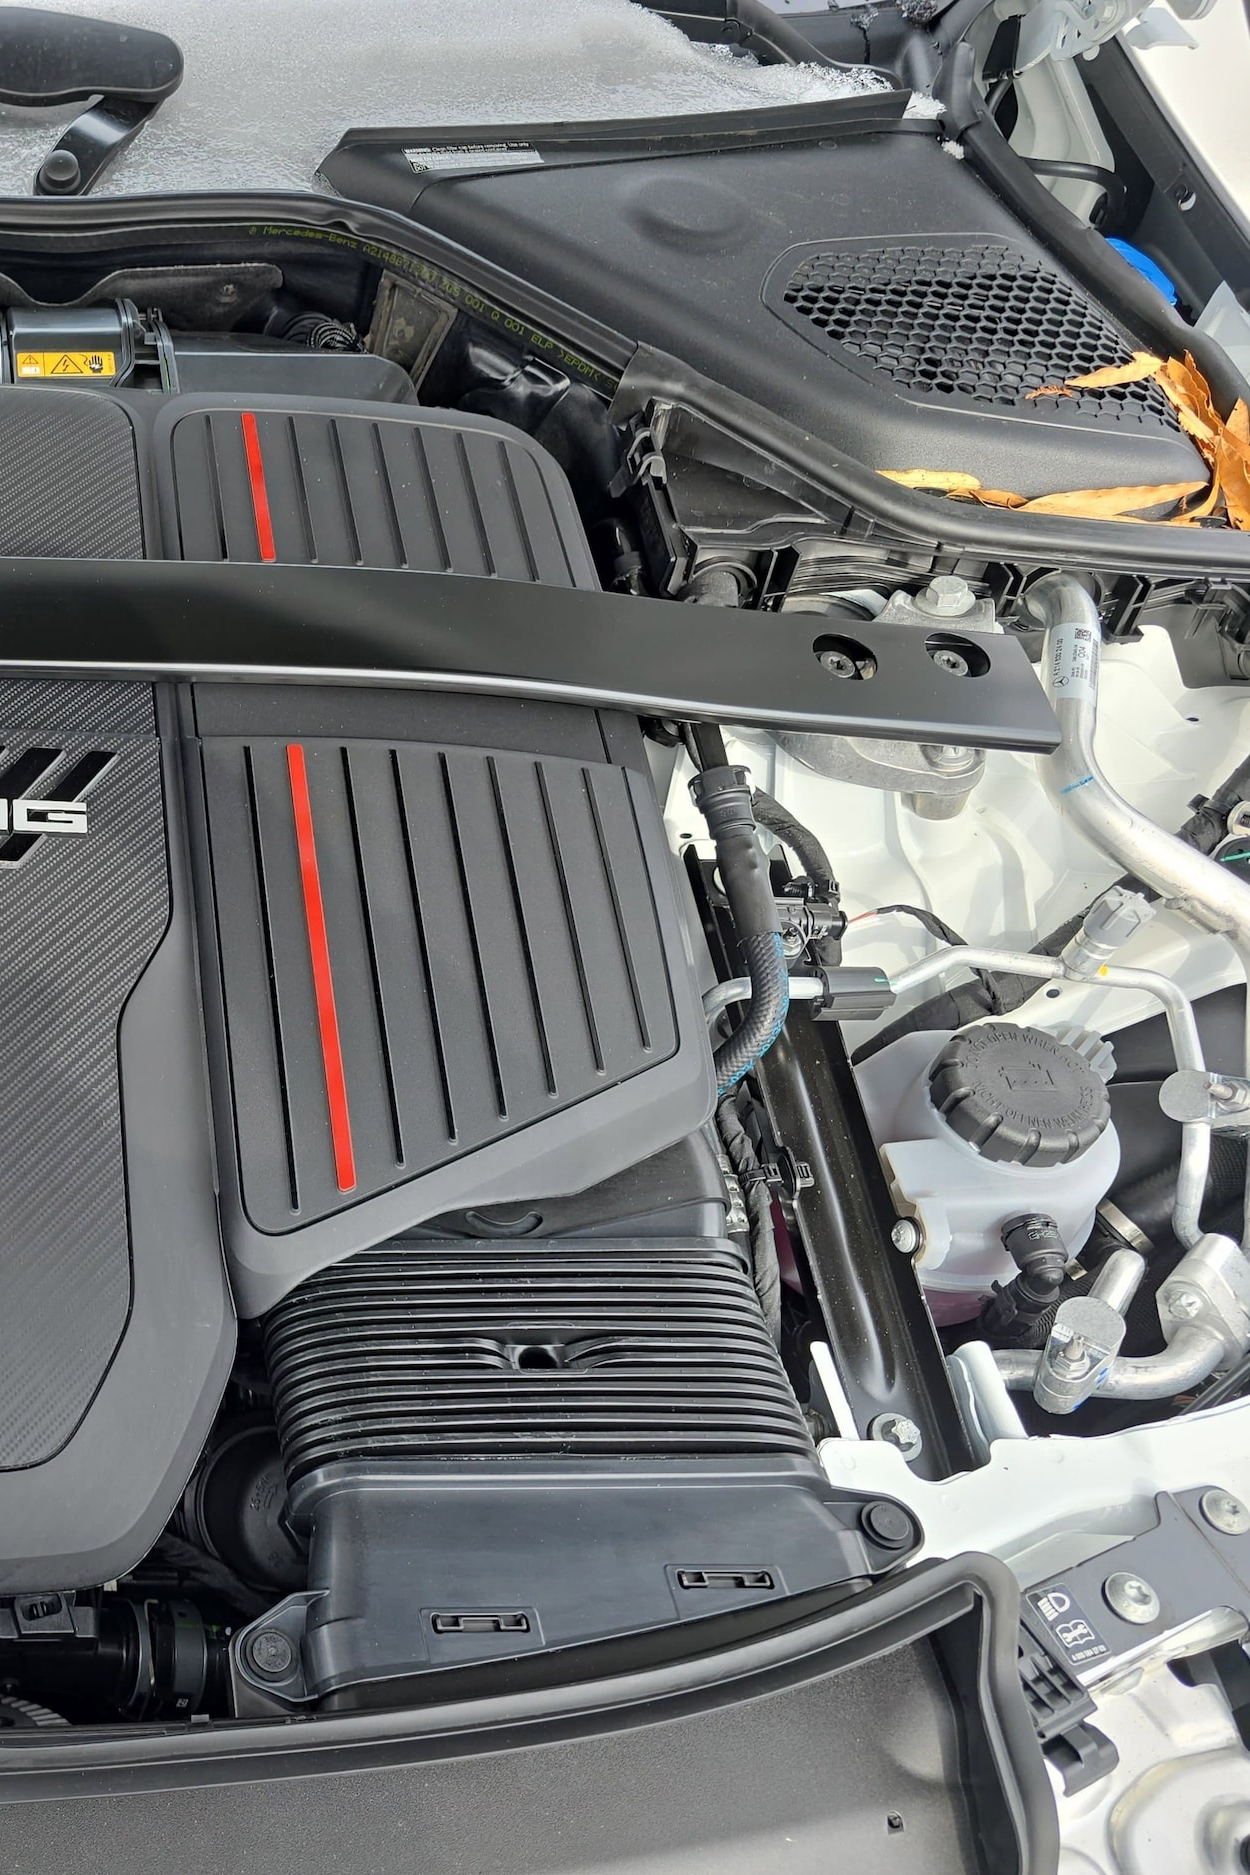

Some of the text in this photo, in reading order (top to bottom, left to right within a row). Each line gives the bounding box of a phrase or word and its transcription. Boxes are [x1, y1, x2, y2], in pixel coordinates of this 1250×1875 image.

[263, 226, 358, 249] Mercedes-Benz
[504, 317, 526, 336] 001
[531, 333, 553, 350] ELP
[559, 349, 601, 381] >EPDM<
